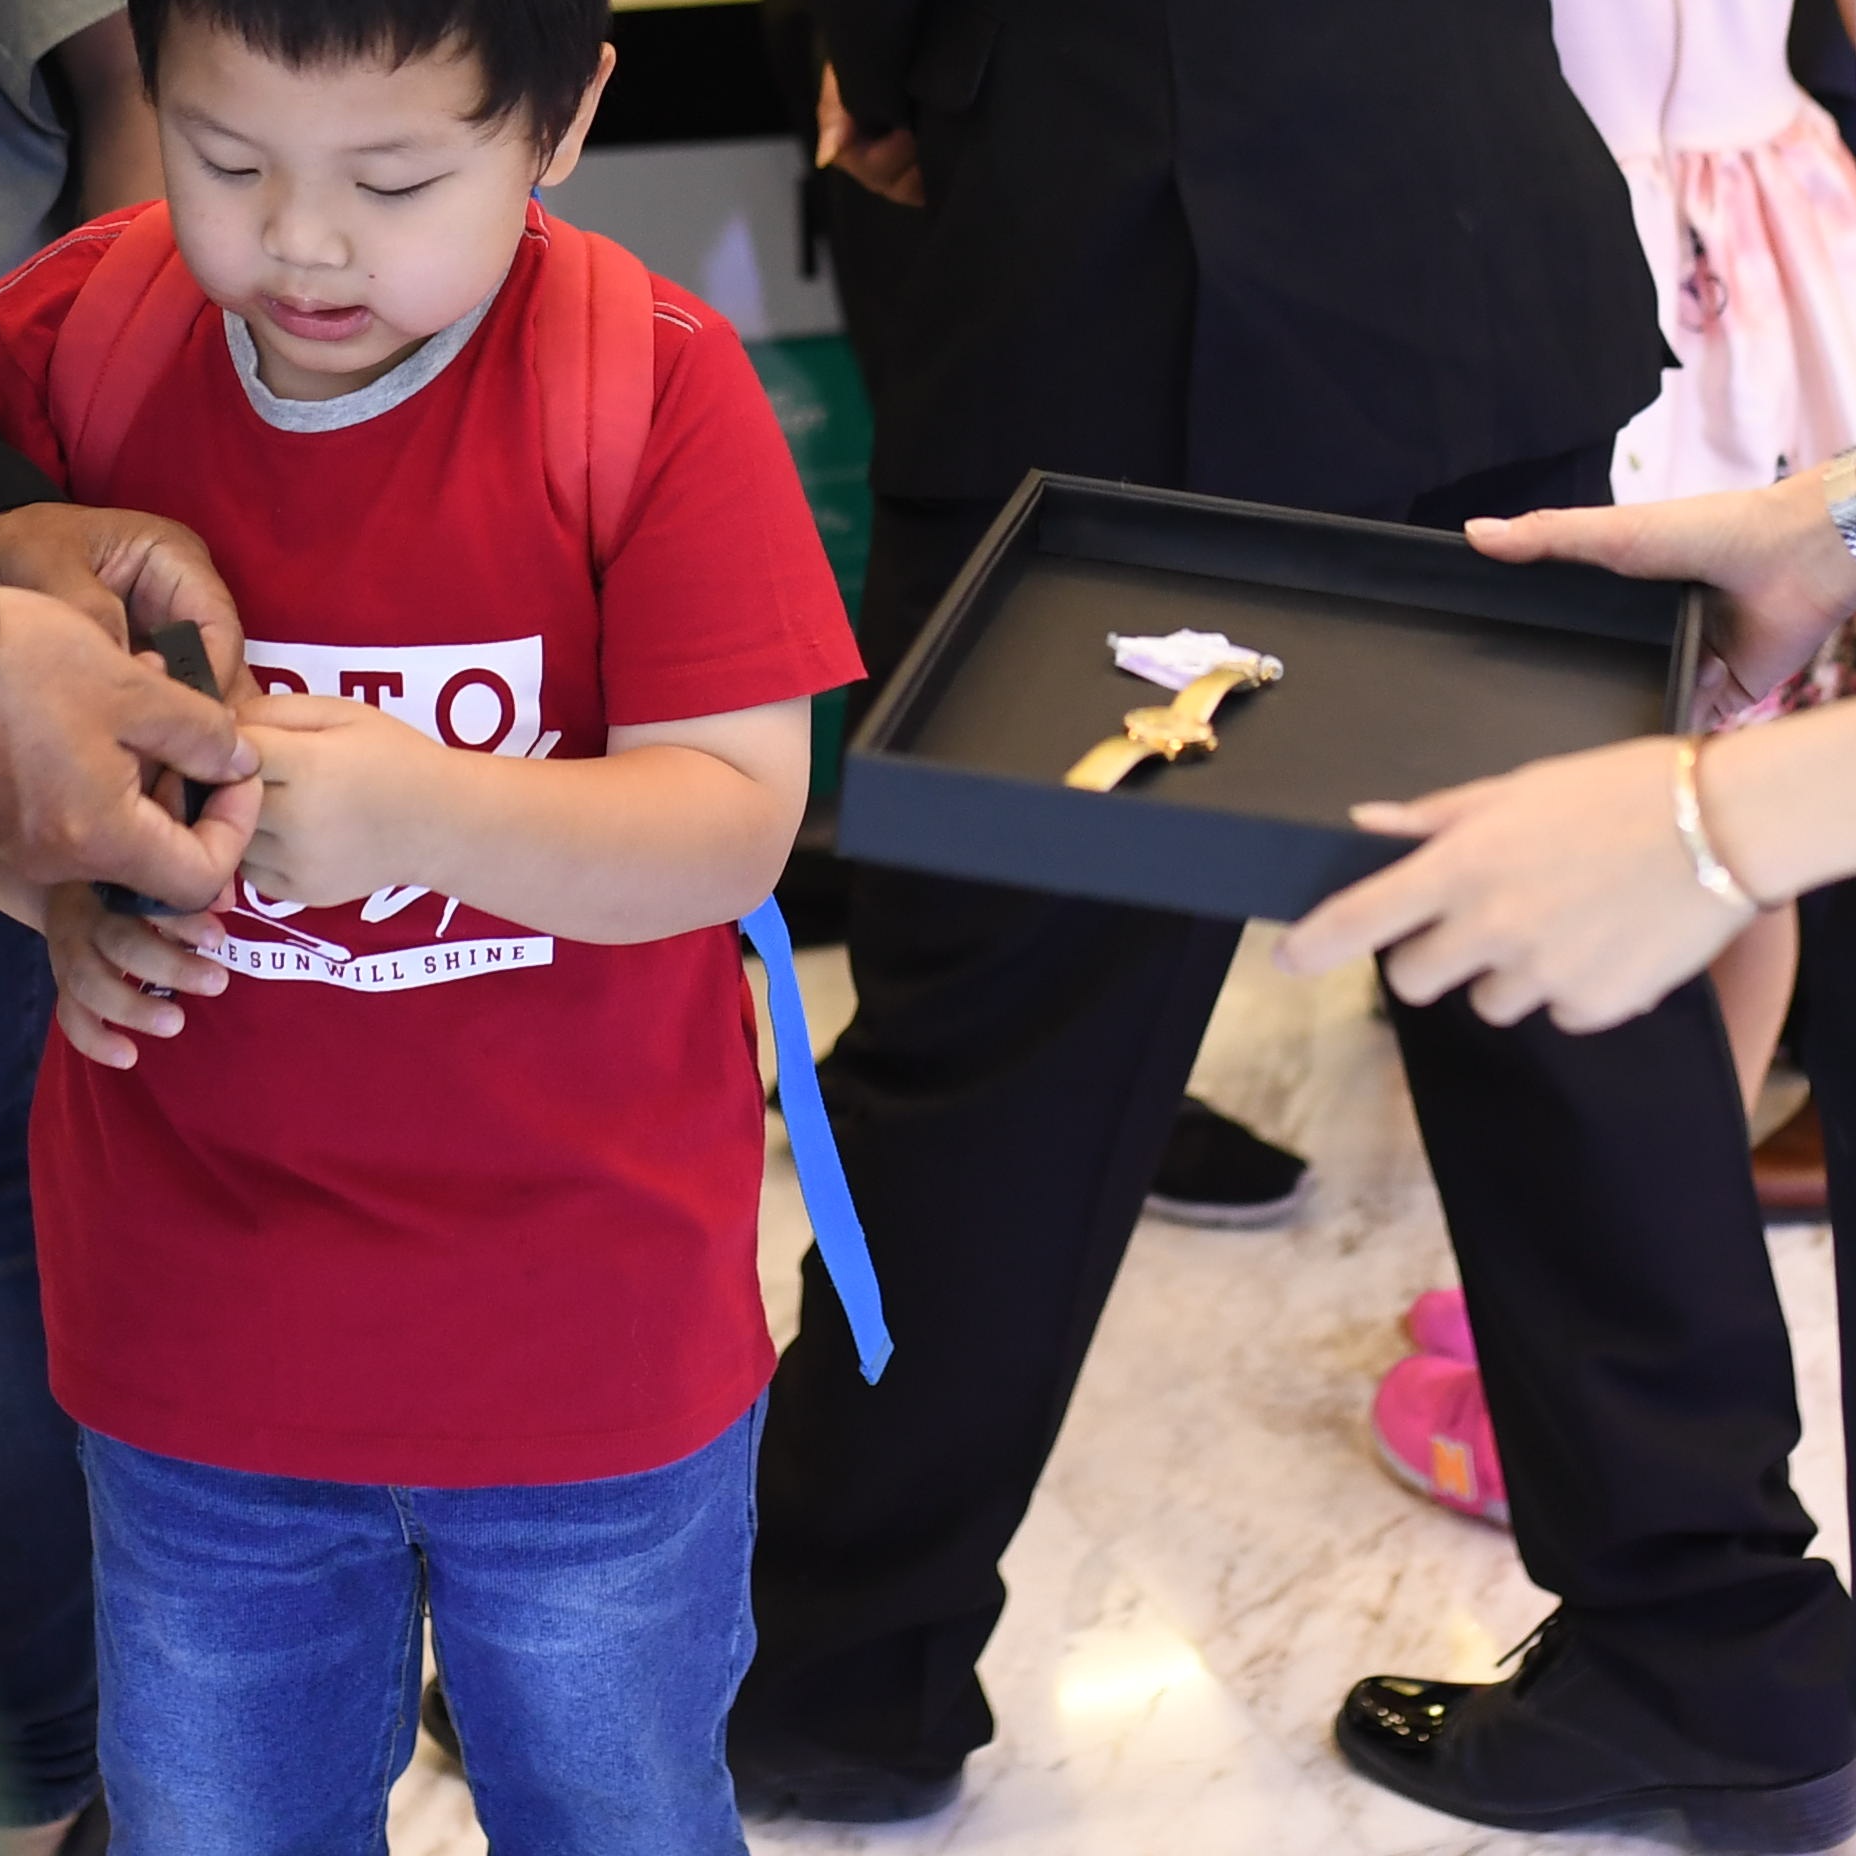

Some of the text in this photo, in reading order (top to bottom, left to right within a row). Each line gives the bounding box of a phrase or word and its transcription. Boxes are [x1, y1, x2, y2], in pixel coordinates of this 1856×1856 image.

[250, 949, 312, 972] SUN
[325, 960, 406, 984] WILL
[424, 945, 527, 975] SHINE
